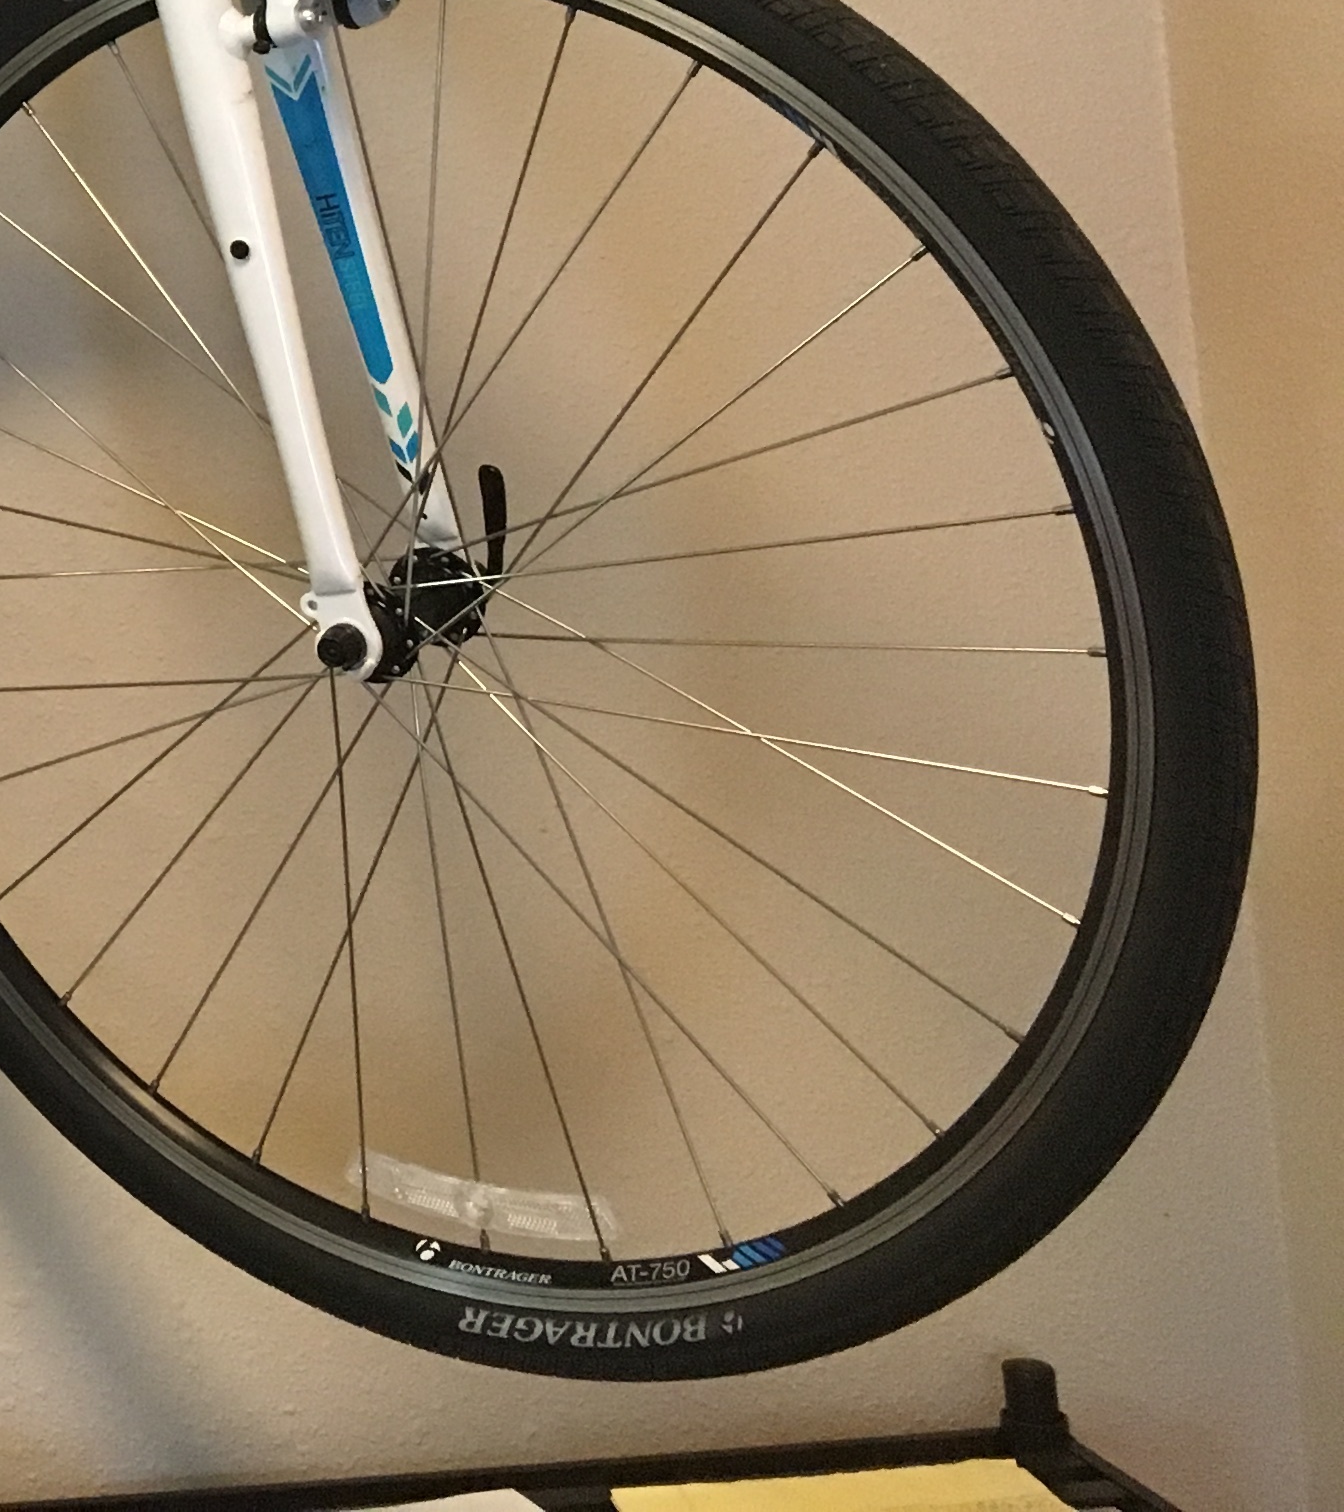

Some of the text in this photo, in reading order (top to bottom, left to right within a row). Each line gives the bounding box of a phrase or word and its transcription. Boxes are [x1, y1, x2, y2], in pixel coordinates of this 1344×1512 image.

[448, 1260, 552, 1285] BONTRAGER
[612, 1260, 691, 1283] AT-750
[458, 1306, 707, 1349] BONTRAGER
